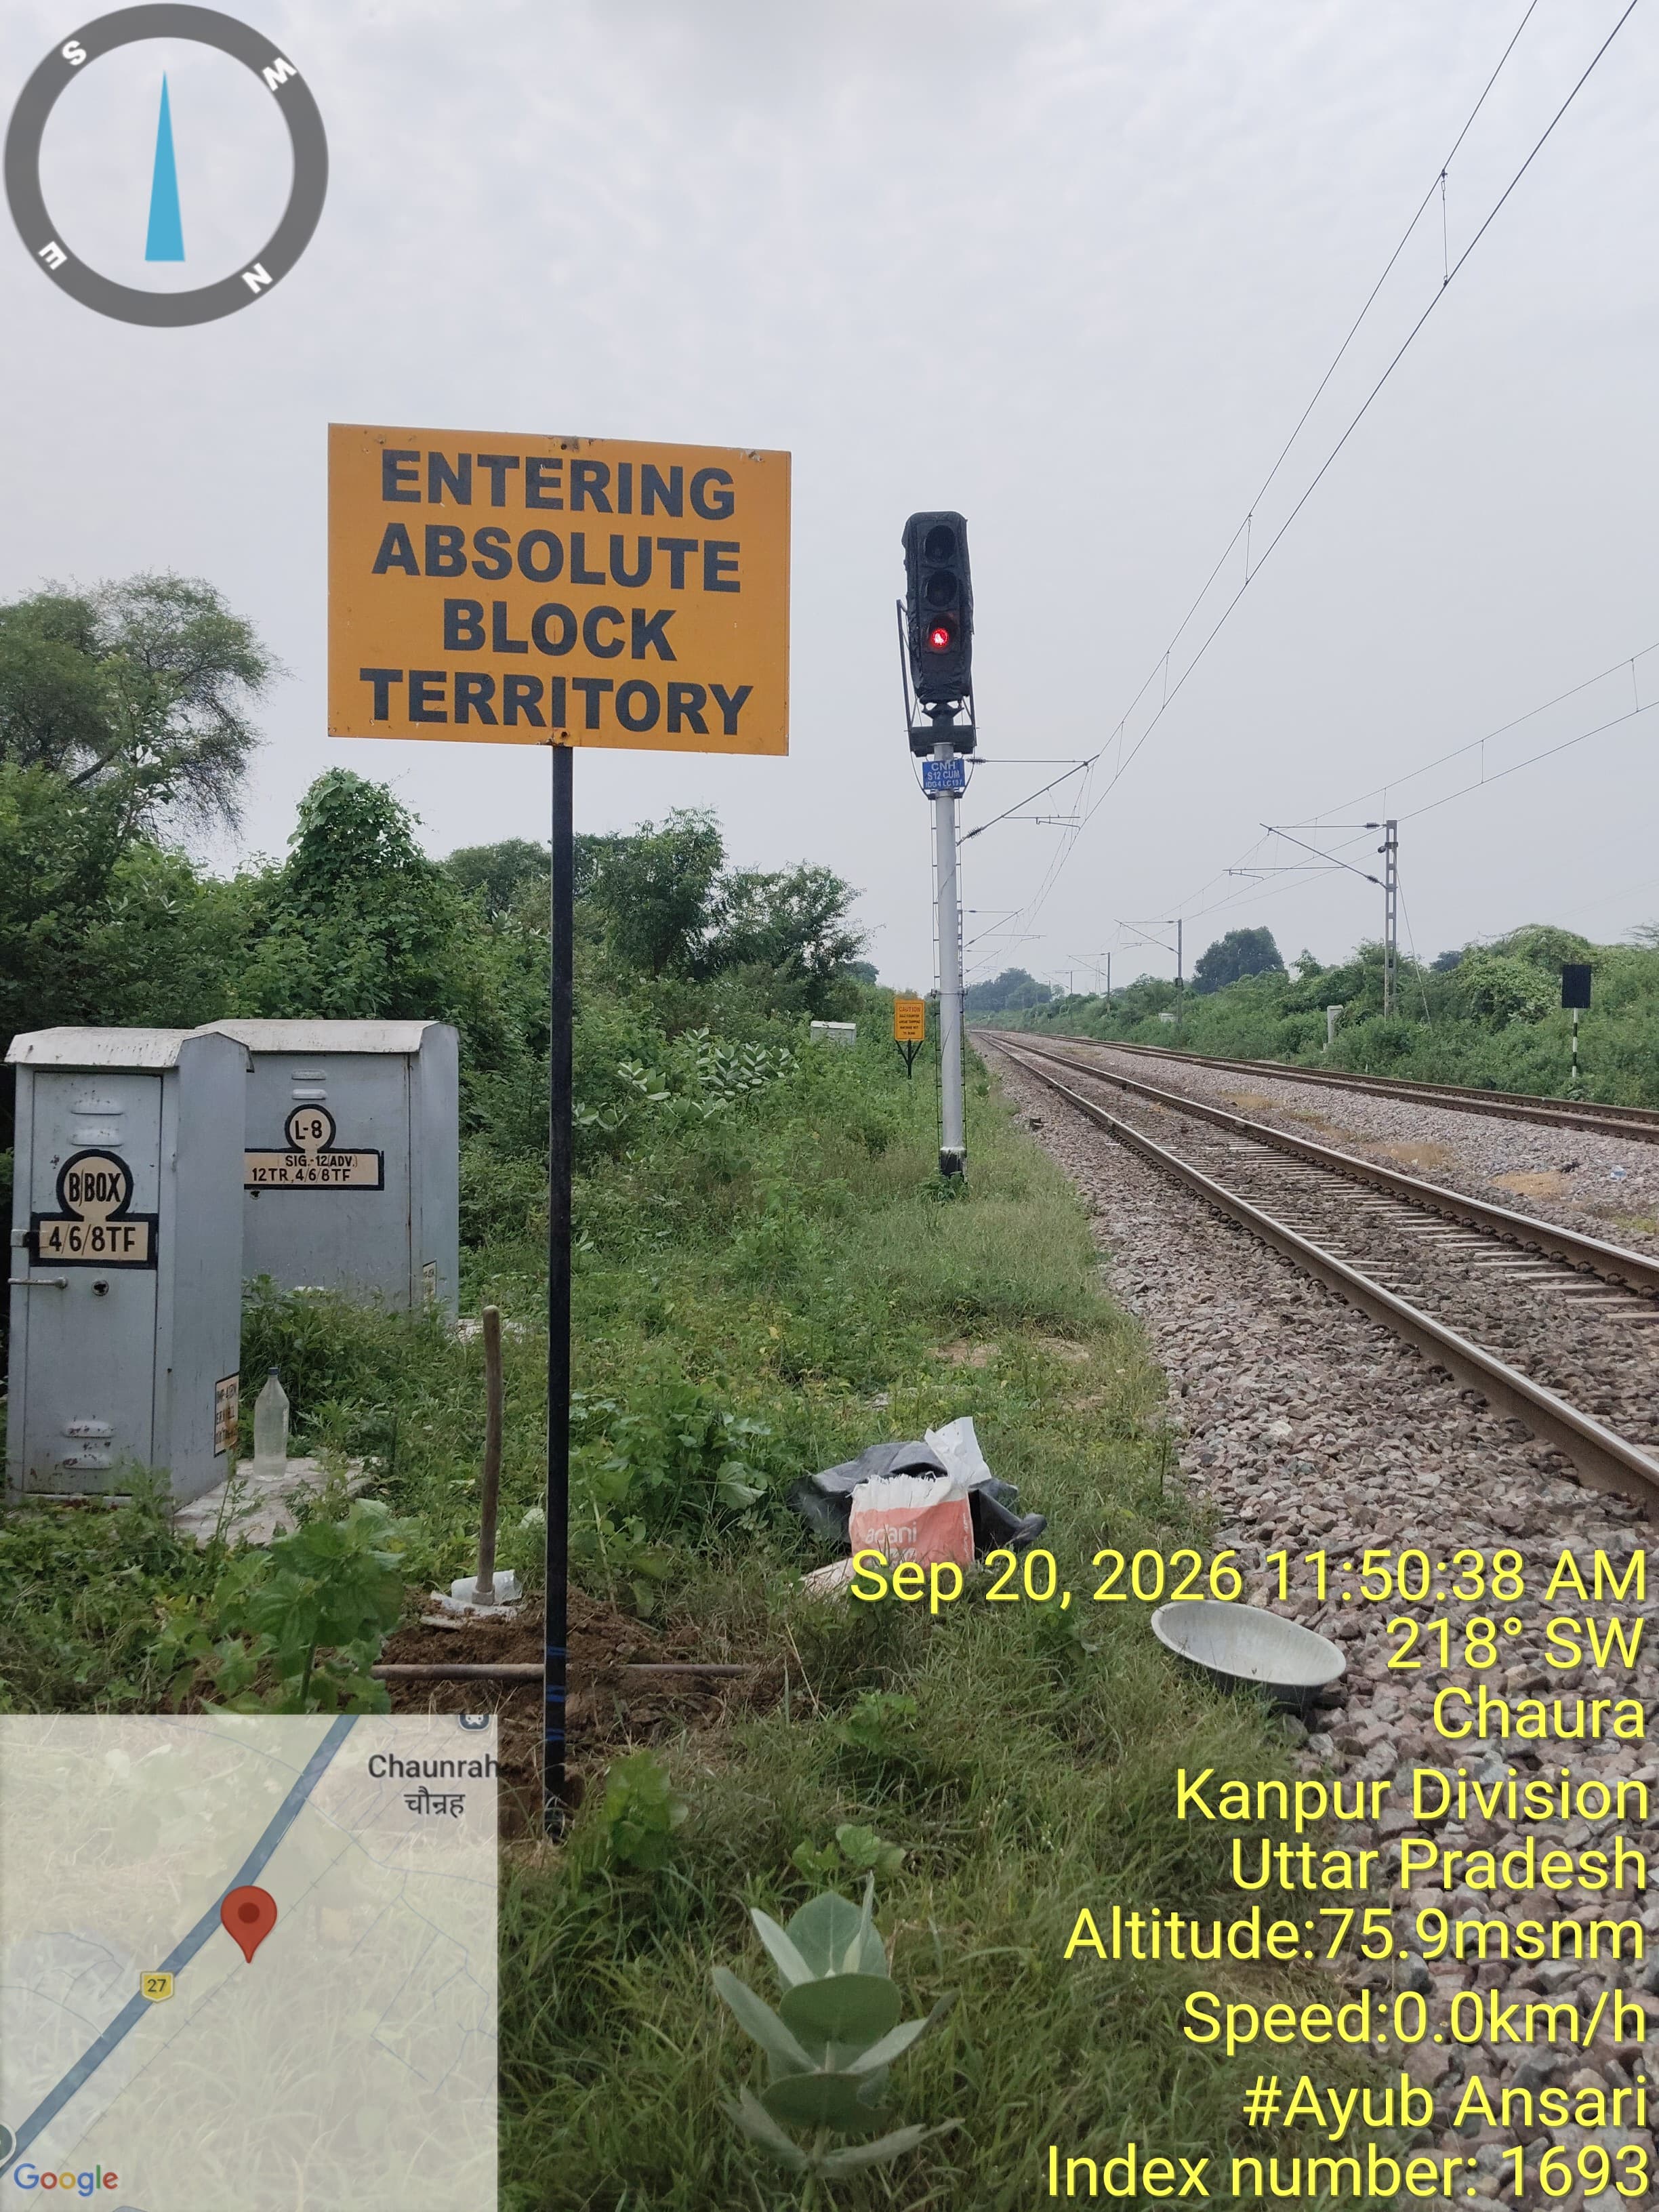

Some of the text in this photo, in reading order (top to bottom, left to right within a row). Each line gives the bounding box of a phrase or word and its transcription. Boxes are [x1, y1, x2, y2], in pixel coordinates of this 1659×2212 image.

[382, 449, 735, 520] ENTERING
[371, 522, 741, 593] ABSOLUTE
[443, 597, 678, 661] BLOCK
[359, 668, 754, 735] TERRITORY
[927, 770, 960, 781] S12 CUM
[931, 761, 956, 771] CNH
[295, 1120, 322, 1140] L-8
[865, 1521, 917, 1544] adani
